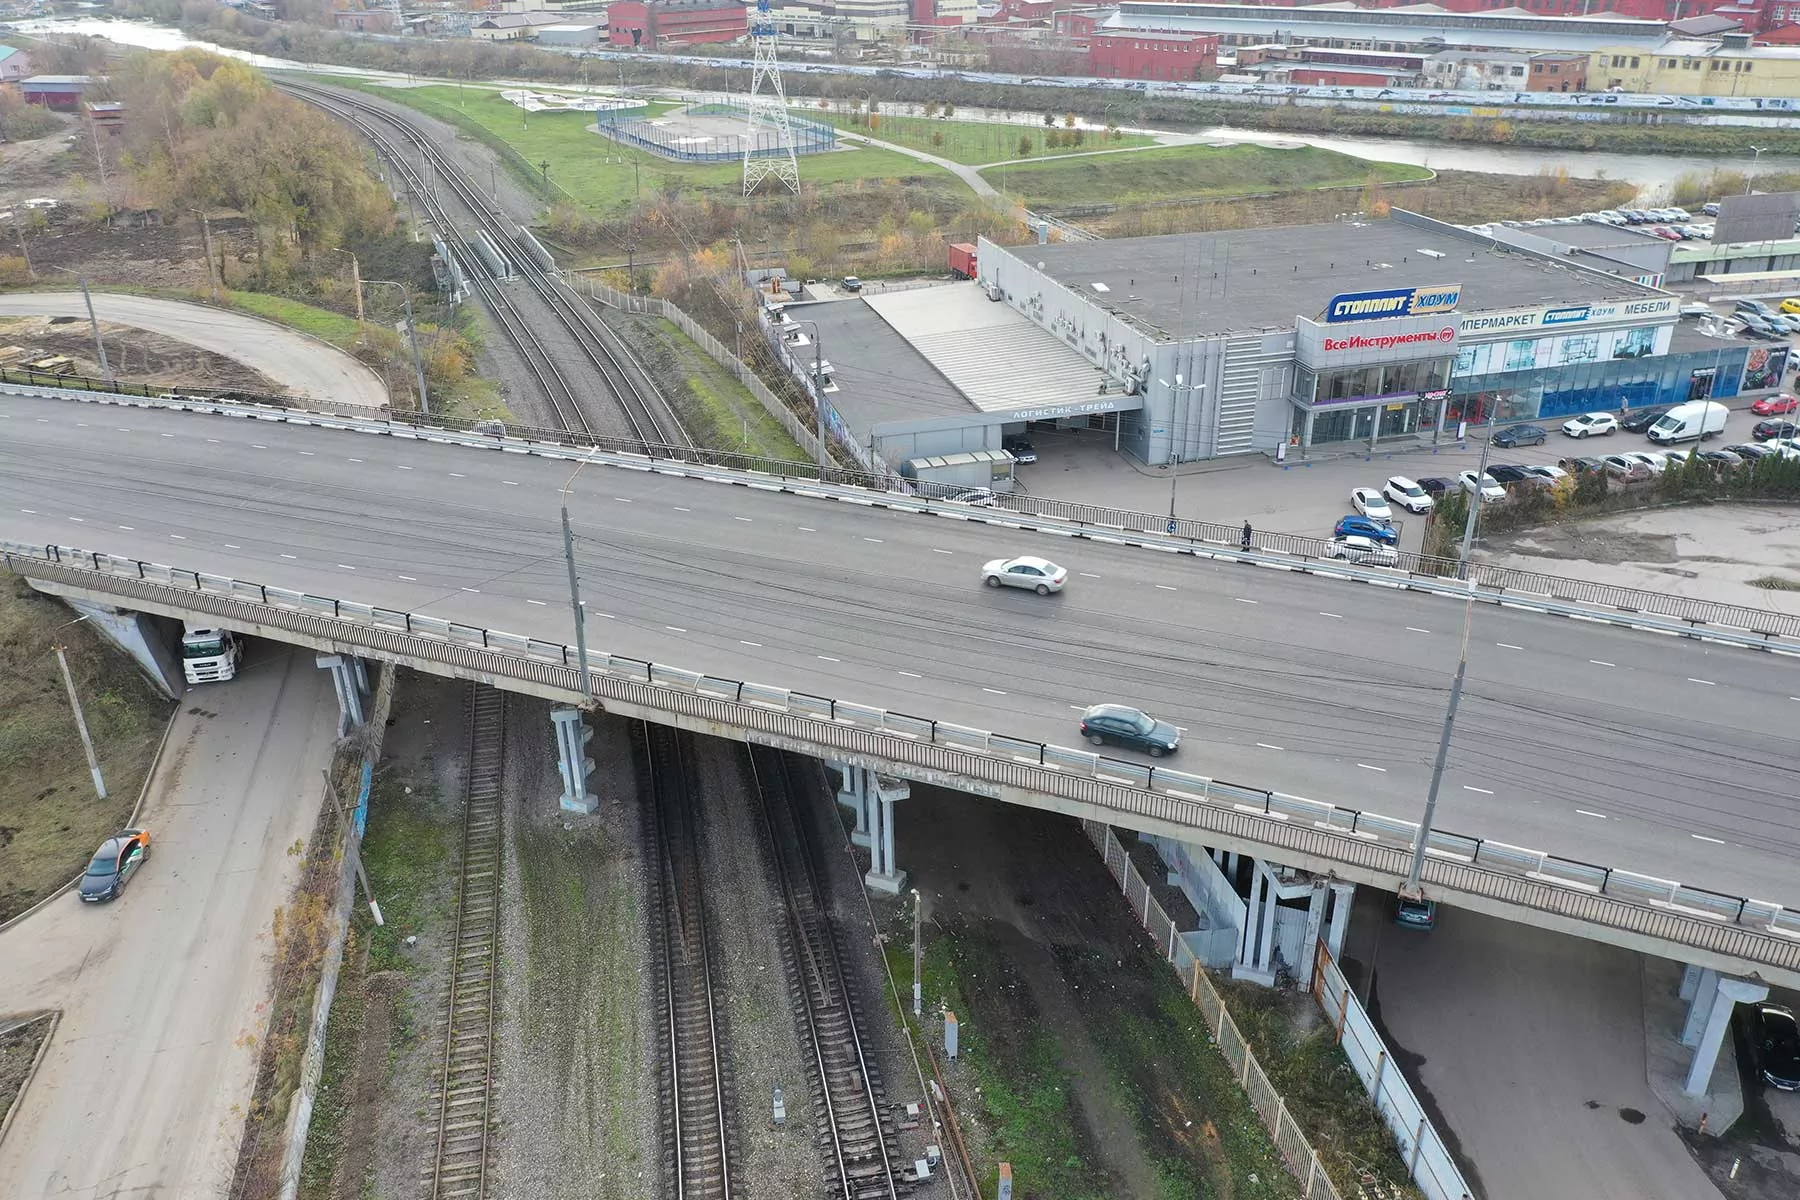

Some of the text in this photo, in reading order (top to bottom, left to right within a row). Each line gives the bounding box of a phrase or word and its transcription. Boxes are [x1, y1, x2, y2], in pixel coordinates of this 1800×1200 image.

[1334, 292, 1458, 316] СТОЛПЛИТ ХОУМ
[1591, 307, 1615, 317] ХОУМ
[1624, 301, 1670, 315] МЕБЕЛИ
